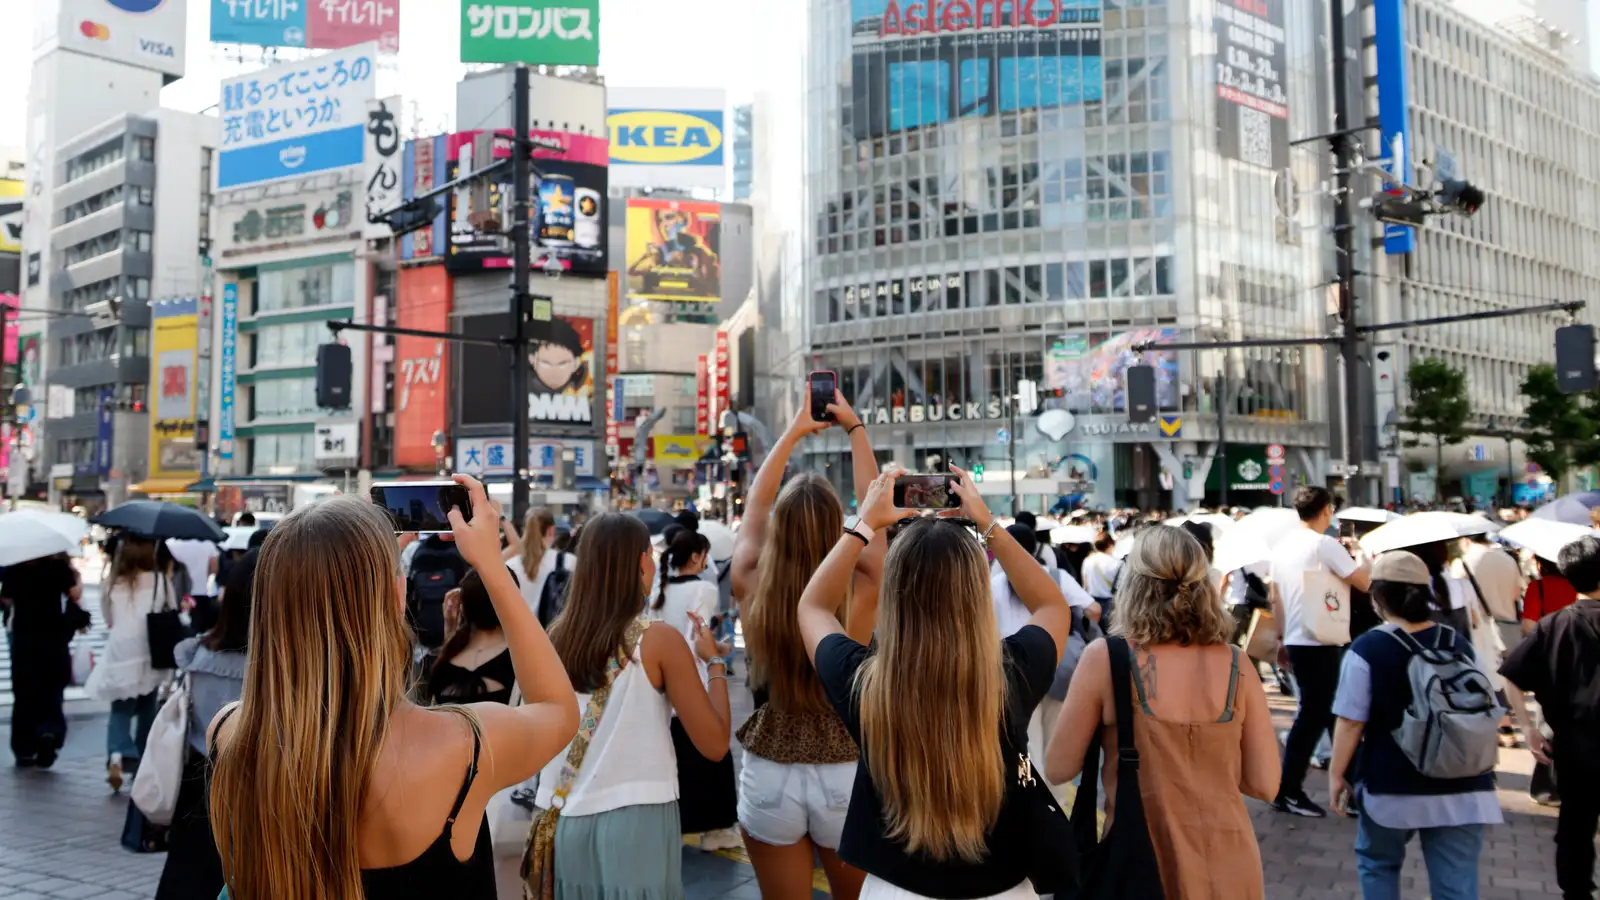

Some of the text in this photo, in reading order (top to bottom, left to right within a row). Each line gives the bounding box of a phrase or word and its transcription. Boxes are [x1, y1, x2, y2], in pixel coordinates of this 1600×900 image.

[467, 3, 593, 40] サロンパス
[879, 0, 1063, 39] Astemo
[139, 37, 175, 58] VISA
[608, 125, 712, 148] KEA
[859, 401, 1002, 425] TARBUCKS
[1082, 422, 1150, 434] TSUTAYA
